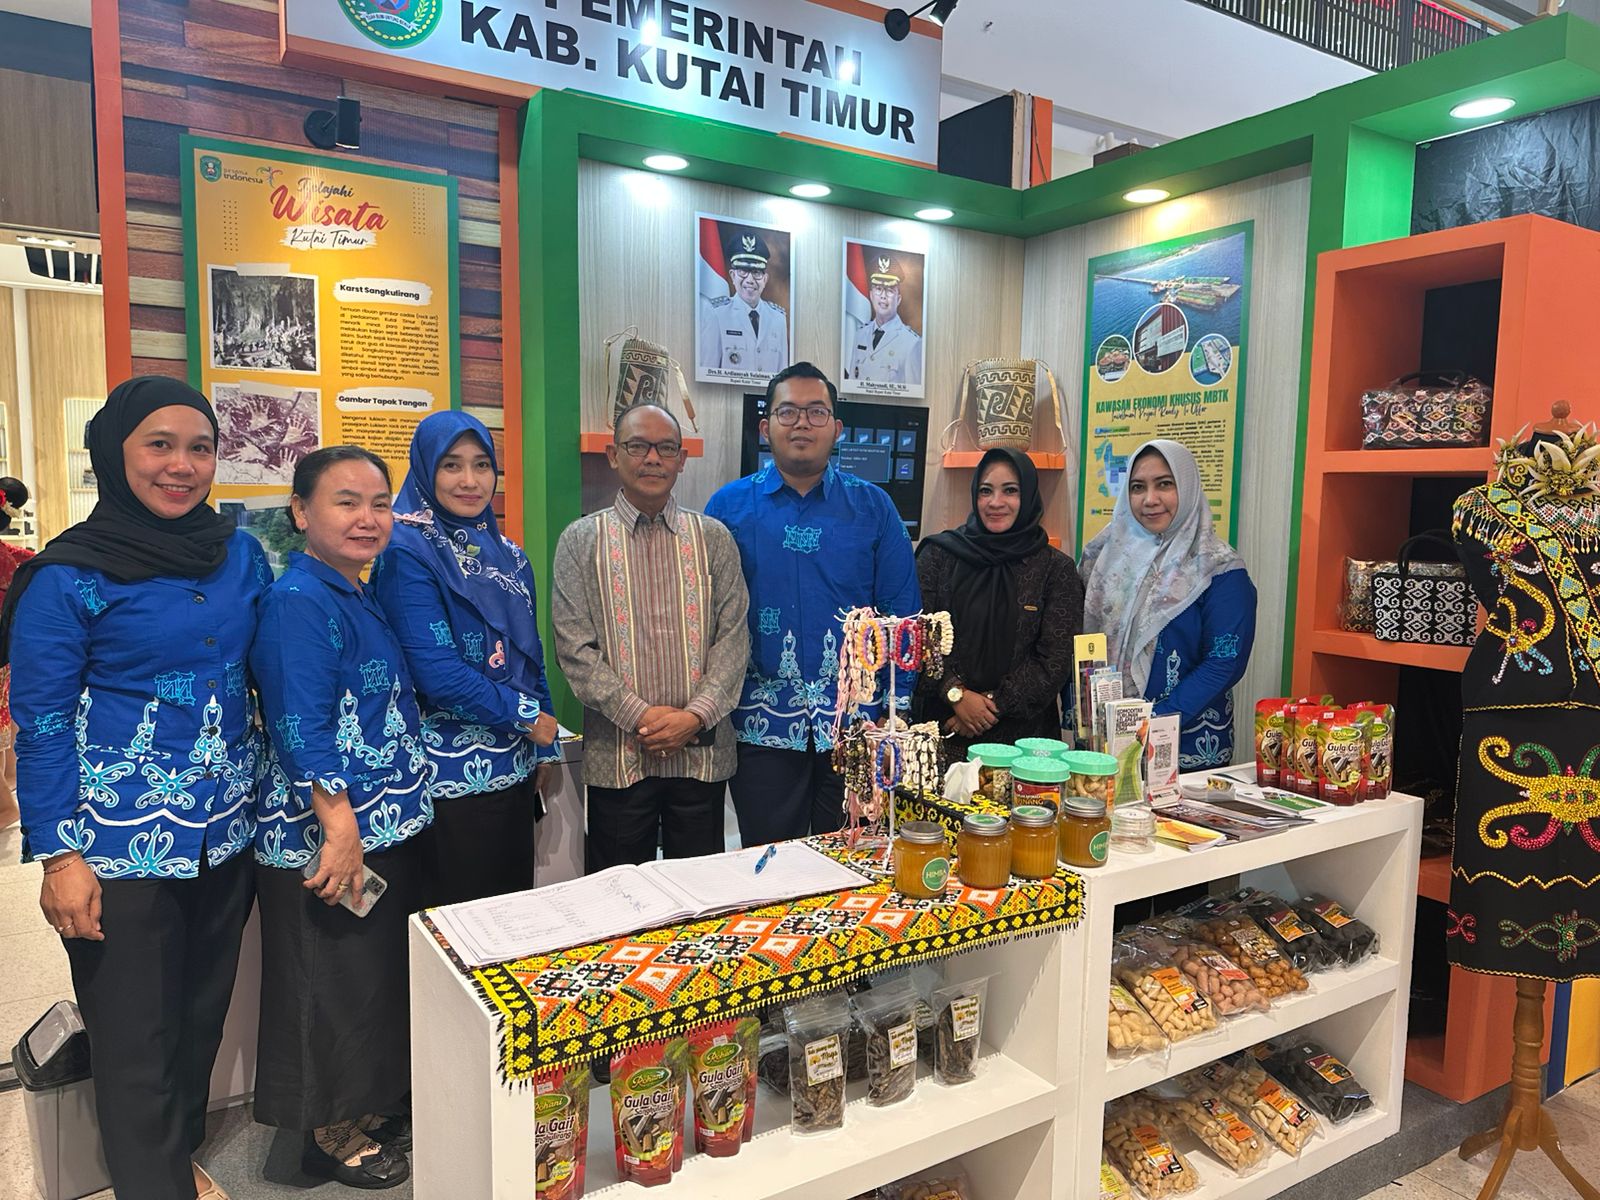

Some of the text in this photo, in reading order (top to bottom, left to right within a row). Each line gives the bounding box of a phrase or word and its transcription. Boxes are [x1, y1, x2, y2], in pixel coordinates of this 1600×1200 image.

[460, 0, 916, 145] KAB. KUTAI TIMUR
[270, 184, 389, 232] Wisata
[330, 229, 369, 248] Timur
[340, 284, 420, 301] Karst Sangkulirang
[338, 396, 428, 408] Gambar Tapak Tangan
[1096, 389, 1229, 414] KAWASAN EKONOMI KHUSUS MBTK
[1327, 742, 1346, 755] Gula
[700, 1061, 745, 1084] Gula Gait
[624, 1092, 650, 1108] Gula
[550, 1115, 575, 1132] Gait
